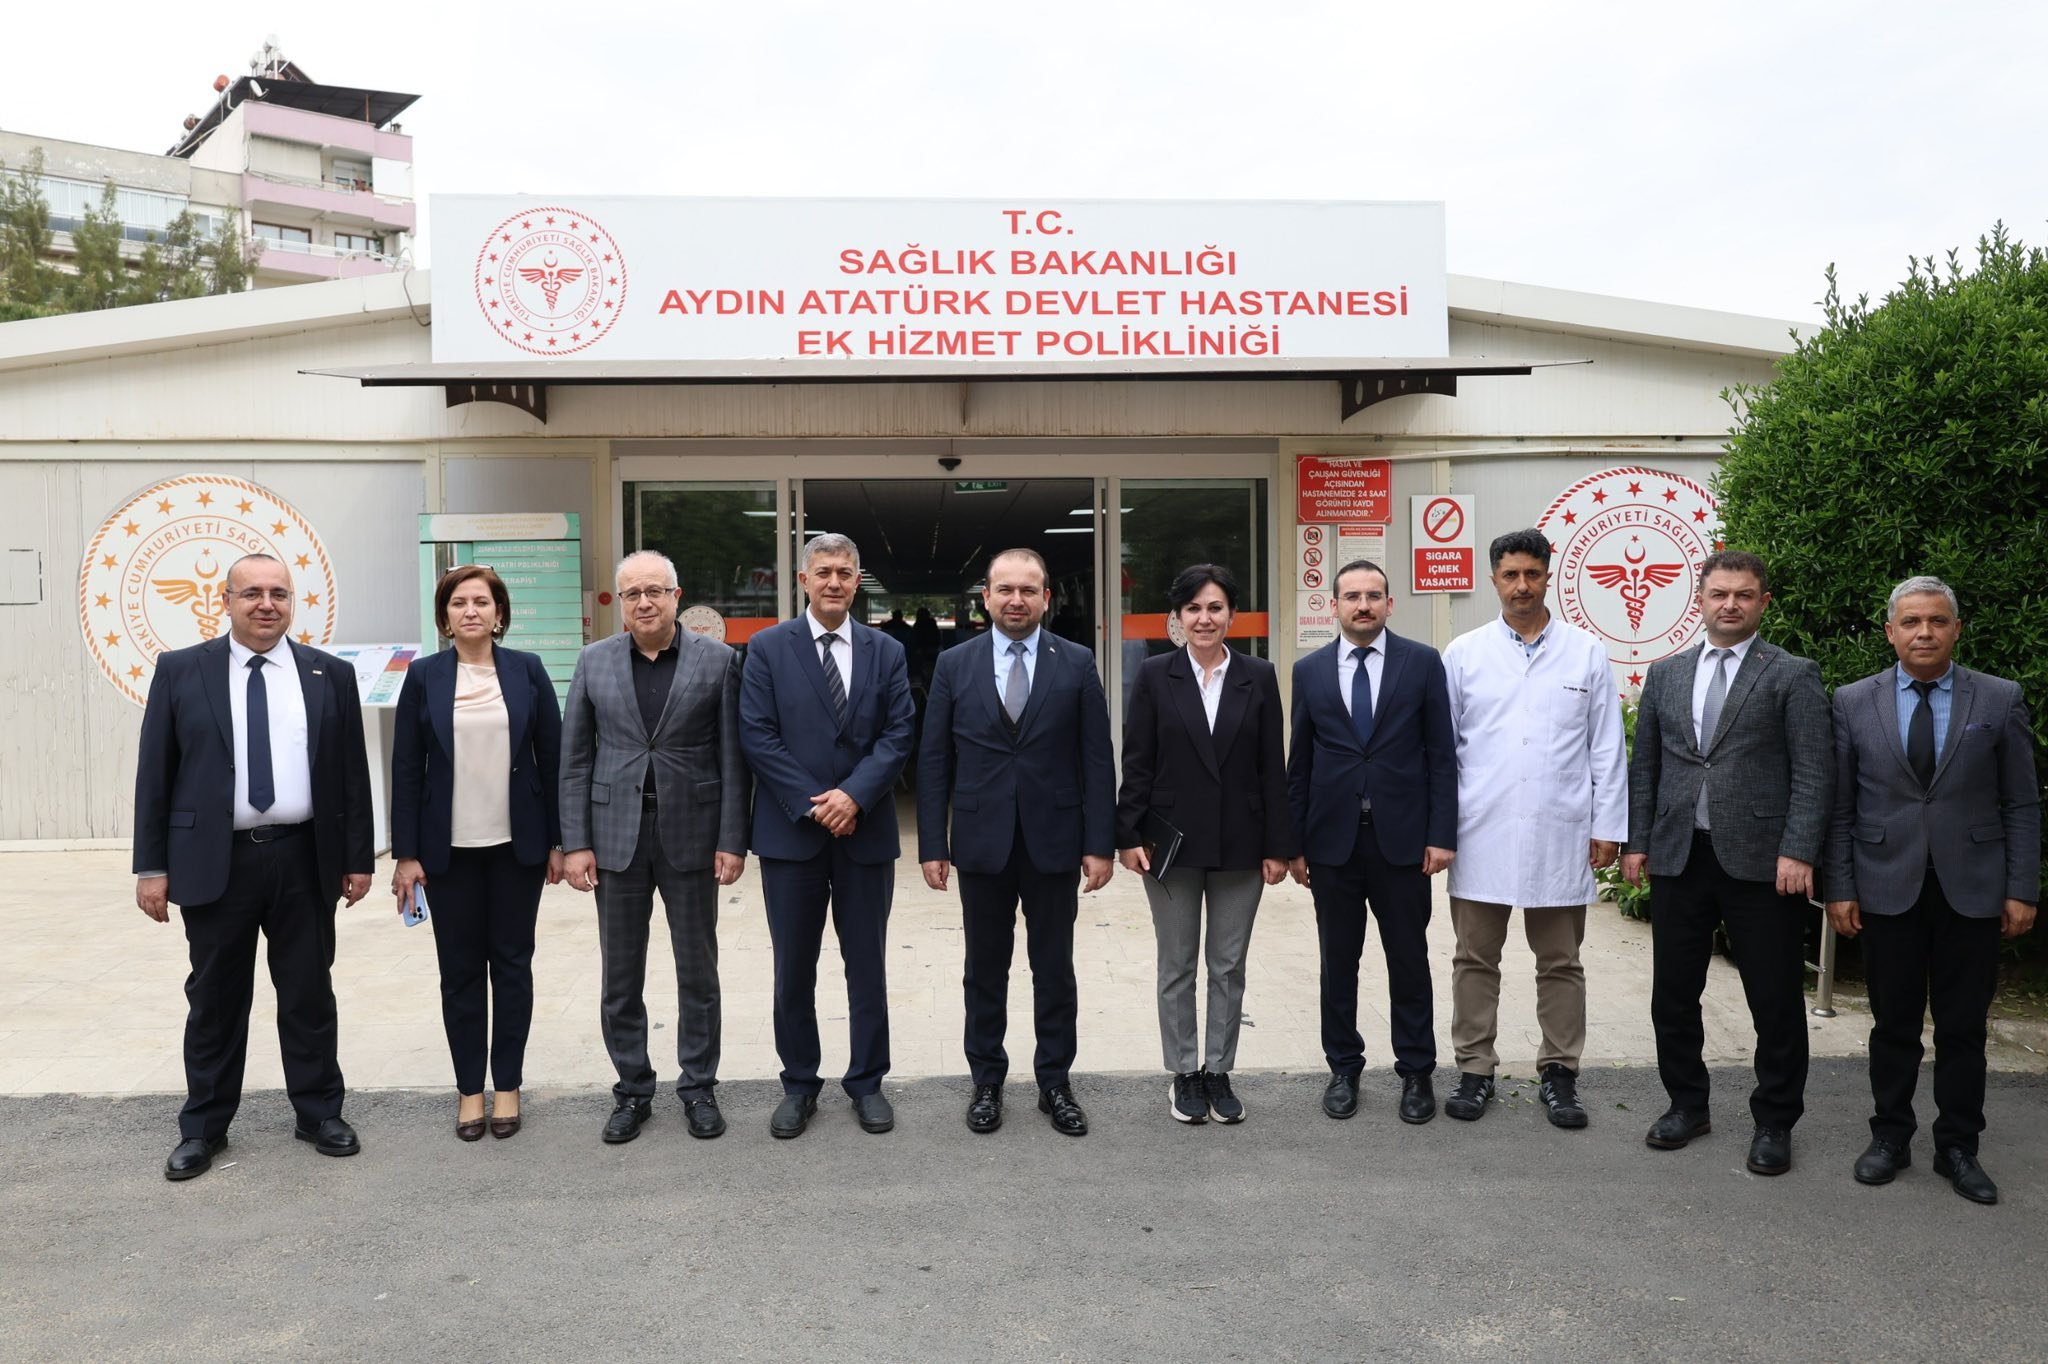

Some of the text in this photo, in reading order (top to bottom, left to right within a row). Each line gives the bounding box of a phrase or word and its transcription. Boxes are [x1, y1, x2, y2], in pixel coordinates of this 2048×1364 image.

[1003, 210, 1074, 235] T.C.
[504, 234, 560, 278] CUMHURİYETİ
[563, 237, 594, 265] SAĞLIK
[839, 244, 1237, 275] SAĞLIK BAKANLIĞI
[658, 284, 1408, 316] AYDIN ATATÜRK DEVLET HASTANESİ
[797, 324, 1280, 356] EK HİZMET POLİKLİNİĞİ
[1308, 469, 1381, 479] ÇALIŞAN GÜVENLİĞİ
[1324, 480, 1365, 489] AÇISINDAN
[1302, 489, 1356, 498] HASTANEMİZDE
[1357, 490, 1367, 498] 24
[1315, 498, 1374, 507] GÖRÜNTÜ KAYDI
[127, 520, 221, 595] CUMHURİYETİ
[1425, 551, 1462, 561] SİGARA
[1564, 509, 1649, 581] CUMHURİYETİ
[1653, 514, 1700, 558] SAĞLIK
[1428, 564, 1460, 574] İÇMEK
[1419, 578, 1469, 587] YASAKTIR
[128, 602, 164, 661] ÜRKİYE
